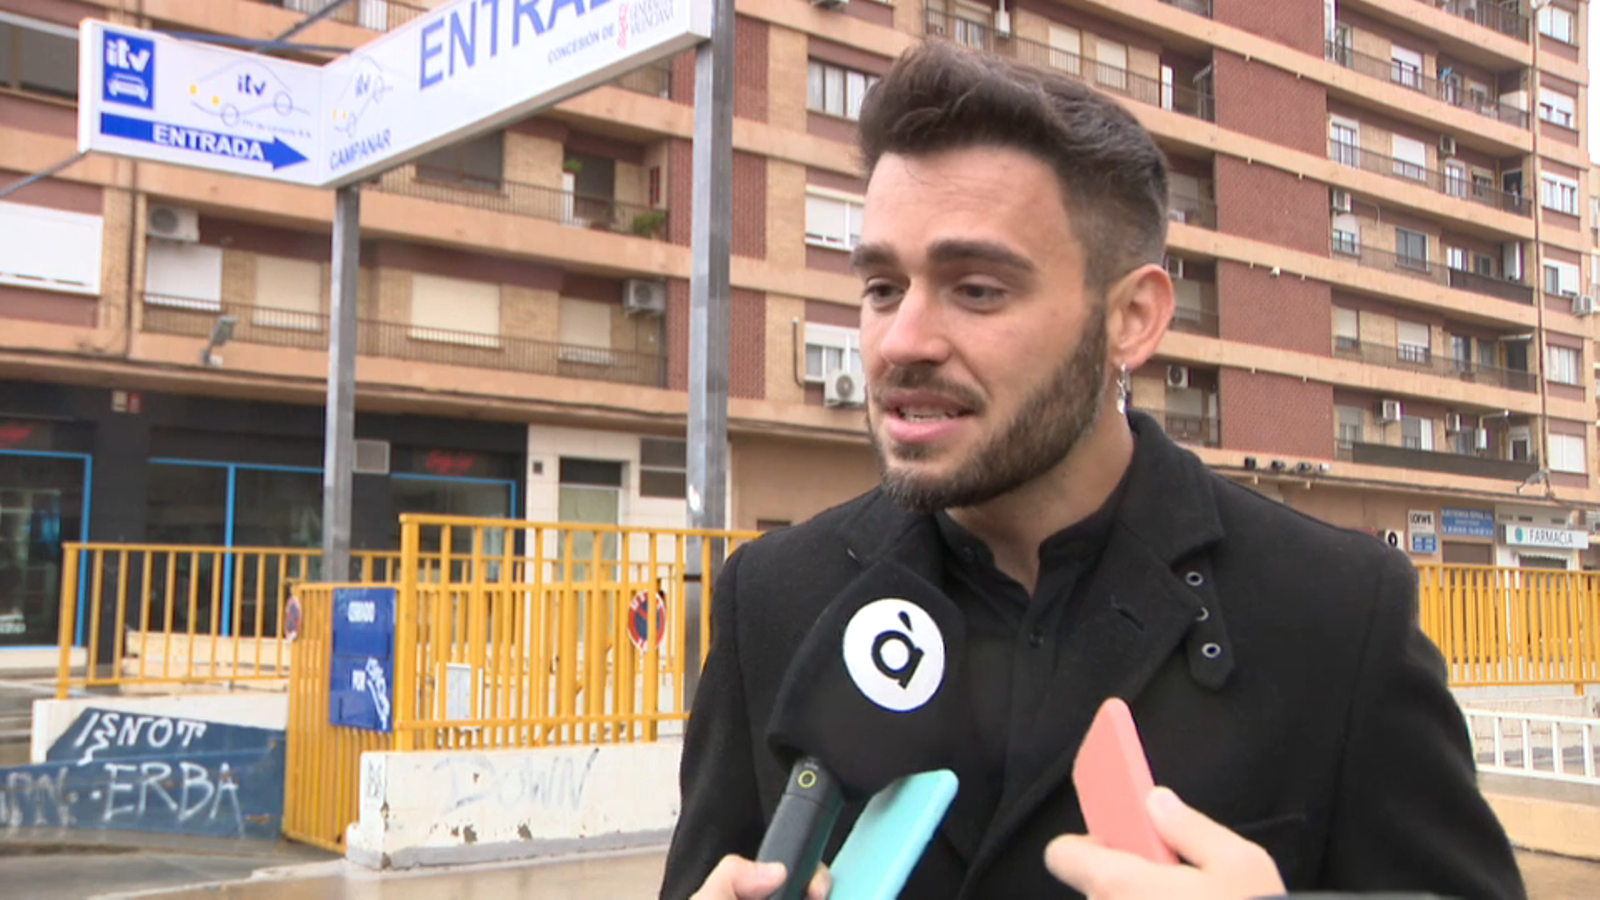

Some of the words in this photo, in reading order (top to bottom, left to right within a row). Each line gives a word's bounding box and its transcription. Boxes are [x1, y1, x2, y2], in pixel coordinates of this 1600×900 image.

[106, 39, 150, 72] itv
[237, 74, 266, 95] itv
[152, 124, 265, 161] ENTRADA
[329, 127, 391, 170] CAMPANAR
[1529, 528, 1574, 545] FARMACIA
